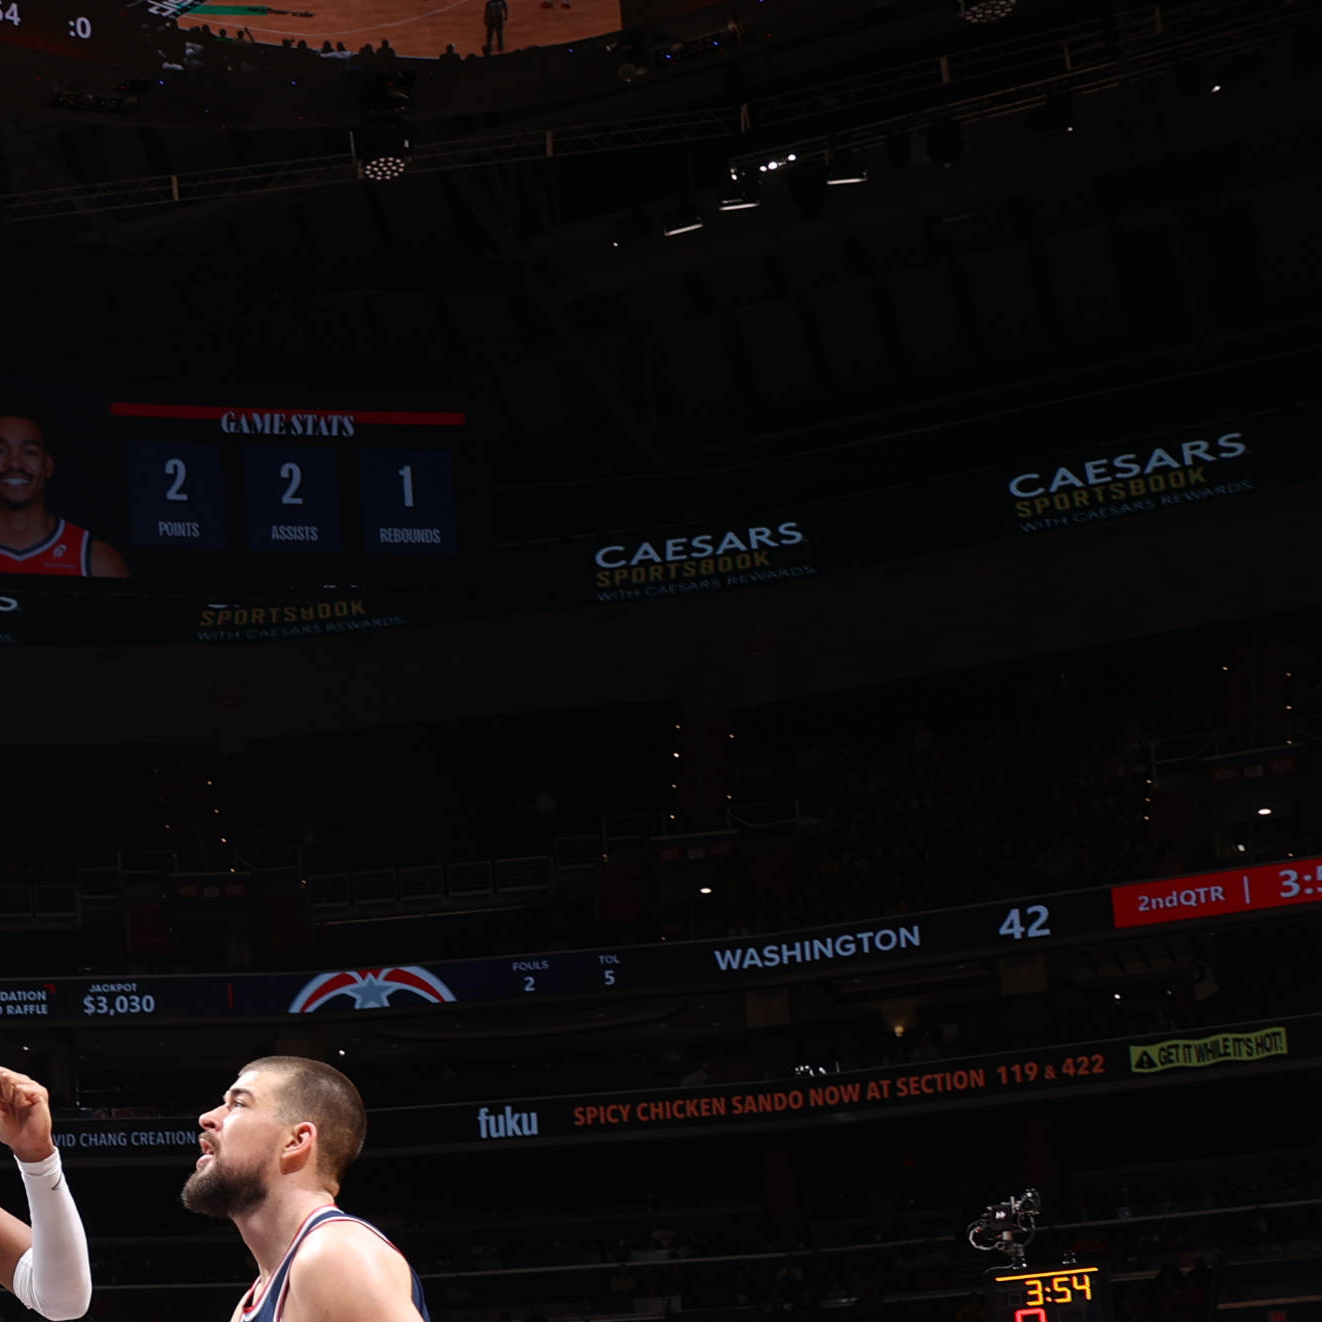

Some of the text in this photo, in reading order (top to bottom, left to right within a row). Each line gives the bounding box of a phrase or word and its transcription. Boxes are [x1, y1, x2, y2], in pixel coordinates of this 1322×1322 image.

[220, 410, 356, 439] GAME STATS
[164, 457, 189, 501] 2
[1008, 432, 1249, 499] CAESARS
[279, 461, 304, 505] 2
[397, 463, 414, 508] 1
[1013, 466, 1209, 520] SPORTSBOOK
[157, 520, 200, 538] POINTS
[270, 524, 319, 543] ASSISTS
[379, 526, 442, 544] REBOUNDS
[594, 521, 806, 569] CAESARS
[596, 550, 772, 588] SPORTSBOOK
[1137, 885, 1226, 912] 2ndQTR
[712, 904, 1052, 972] WASHINGTON 42
[512, 959, 549, 973] FOULS
[598, 953, 621, 966] TOL
[88, 983, 137, 994] JACKPOT
[523, 976, 535, 992] 2
[604, 970, 616, 986] 5
[6, 1003, 49, 1016] RAFFLE
[83, 994, 156, 1017] $3,030
[1158, 1045, 1180, 1066] GET
[1195, 1038, 1230, 1062] WHILE
[477, 1053, 1107, 1139] fuku SPICY CHICKEN SANDO NOW AT SECTION 119 & 422
[53, 1130, 196, 1148] VID CHANG CREATION
[1023, 1273, 1093, 1306] 3:54
